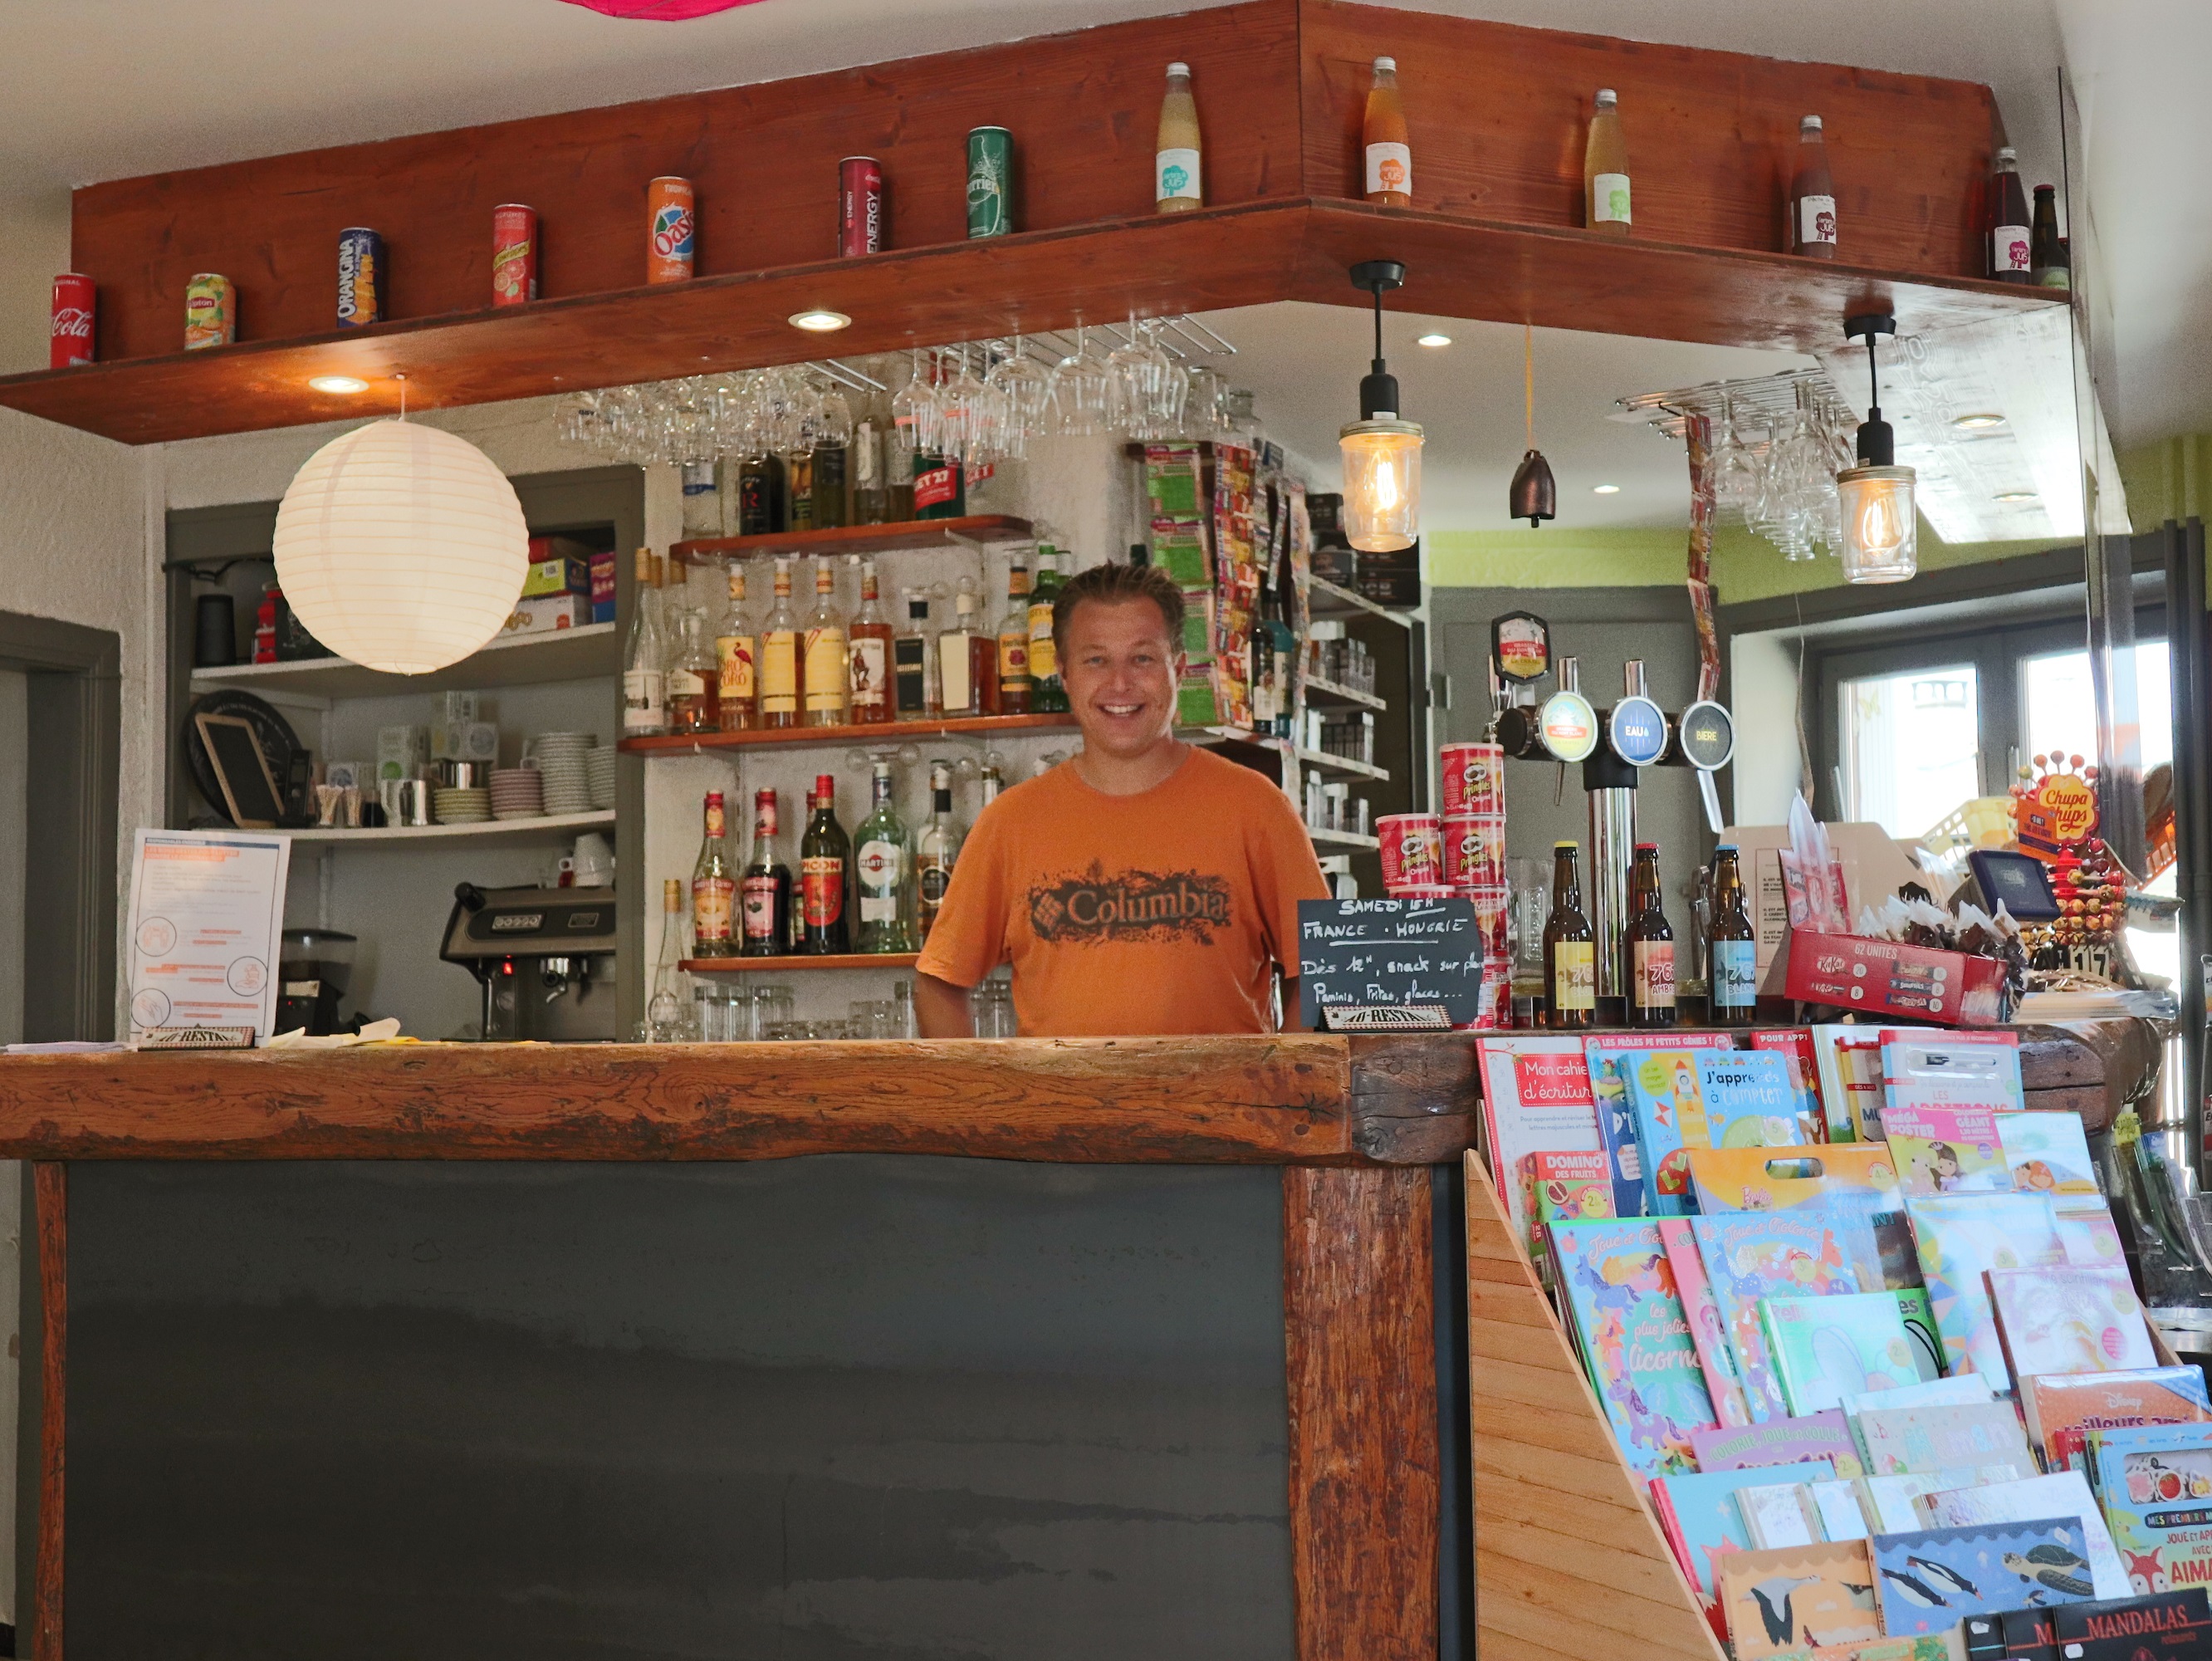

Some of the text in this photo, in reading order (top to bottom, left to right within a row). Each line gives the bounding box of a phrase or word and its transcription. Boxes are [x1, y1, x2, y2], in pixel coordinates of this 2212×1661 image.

[338, 239, 355, 318] ORANGINA
[51, 307, 92, 337] Cola
[1625, 726, 1643, 737] EAU
[1463, 780, 1491, 800] Pringles
[2046, 790, 2088, 809] Chupa
[2051, 806, 2087, 832] hups
[1401, 852, 1428, 874] Pringles
[1461, 851, 1488, 871] Pringles
[1067, 881, 1226, 925] Columbia
[1304, 919, 1468, 939] FRANCE HONGRIE
[1855, 943, 1897, 959] 62 UNITÉS
[1387, 955, 1429, 973] snack
[1440, 962, 1460, 973] sur
[1602, 1038, 1615, 1046] LES
[1646, 1037, 1654, 1046] DE
[1657, 1036, 1681, 1046] PETITS
[1524, 1061, 1588, 1076] Mon cahie
[1524, 1080, 1592, 1100] d'écritur
[1710, 1090, 1719, 1104] à
[1933, 1090, 1949, 1100] LES
[1887, 1110, 1920, 1124] MÉGA
[1956, 1115, 1991, 1128] GÉANT
[1889, 1124, 1936, 1139] POSTER
[1546, 1155, 1603, 1169] DOMINO
[1555, 1170, 1568, 1178] DES
[1724, 1222, 1752, 1247] Joue
[1767, 1217, 1821, 1241] Colorie
[1588, 1234, 1621, 1261] Joue
[1623, 1234, 1637, 1245] et
[1650, 1303, 1667, 1319] les
[1634, 1320, 1659, 1342] plus
[2102, 1391, 2143, 1412] Disney
[1761, 1427, 1792, 1445] JOUE
[1803, 1425, 1841, 1442] COLLE
[2147, 1514, 2166, 1526] MES
[2166, 1531, 2199, 1544] JOUE ET
[2087, 1604, 2190, 1640] MANDALAS
